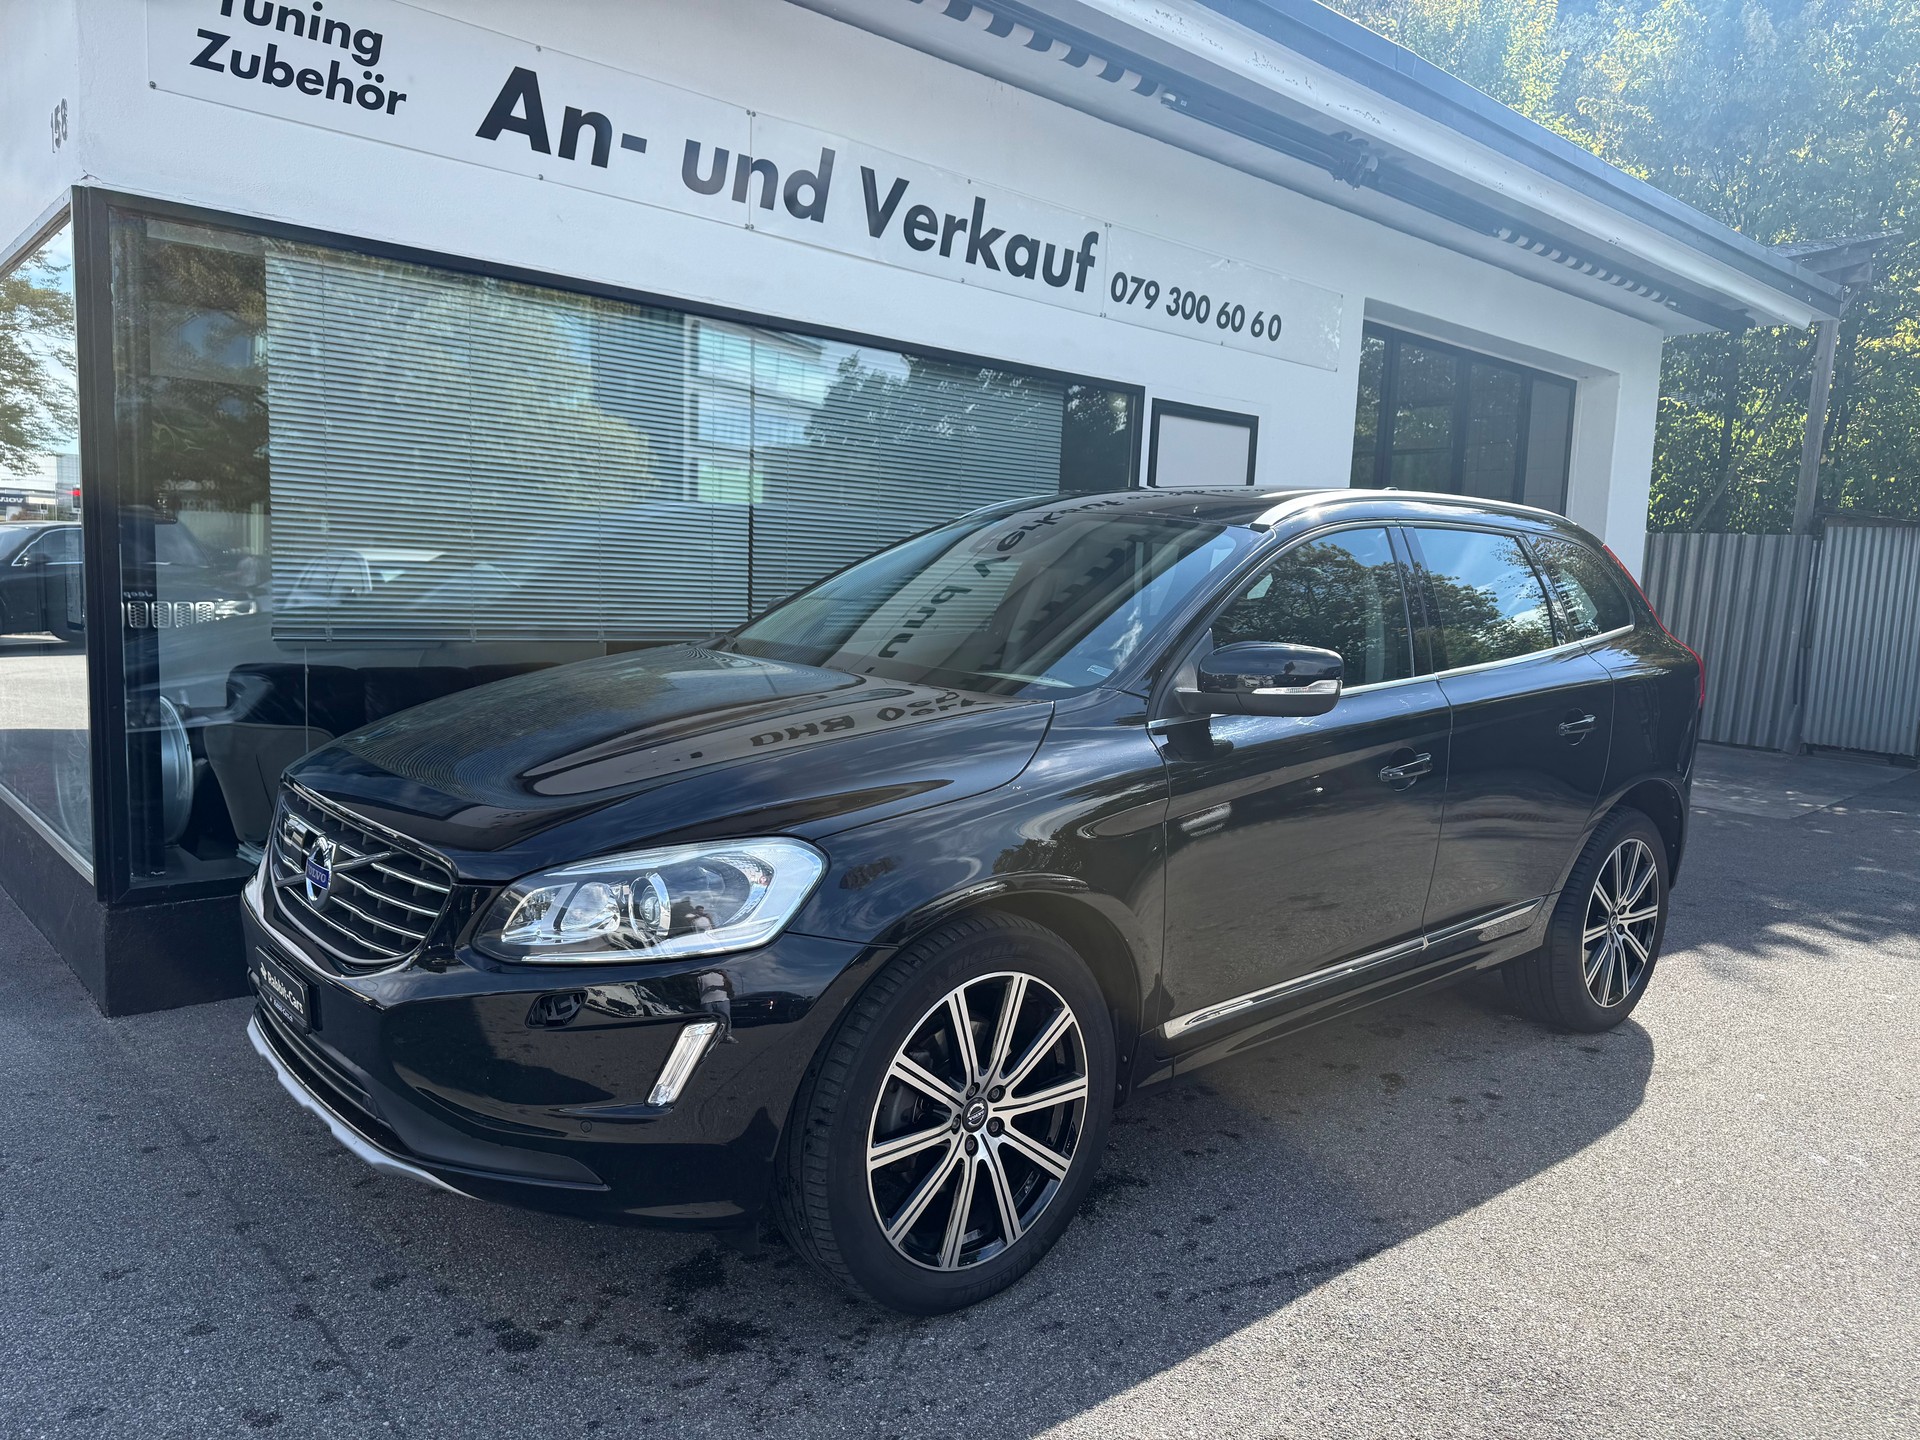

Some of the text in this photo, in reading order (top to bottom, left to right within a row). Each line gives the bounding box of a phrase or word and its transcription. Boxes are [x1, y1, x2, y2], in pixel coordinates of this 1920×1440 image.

[189, 28, 407, 115] Zubehör
[50, 98, 68, 154] 158
[475, 66, 1099, 293] An- und Verkauf
[1110, 271, 1160, 310] 079
[1165, 286, 1211, 324] 300
[1216, 301, 1246, 333] 60
